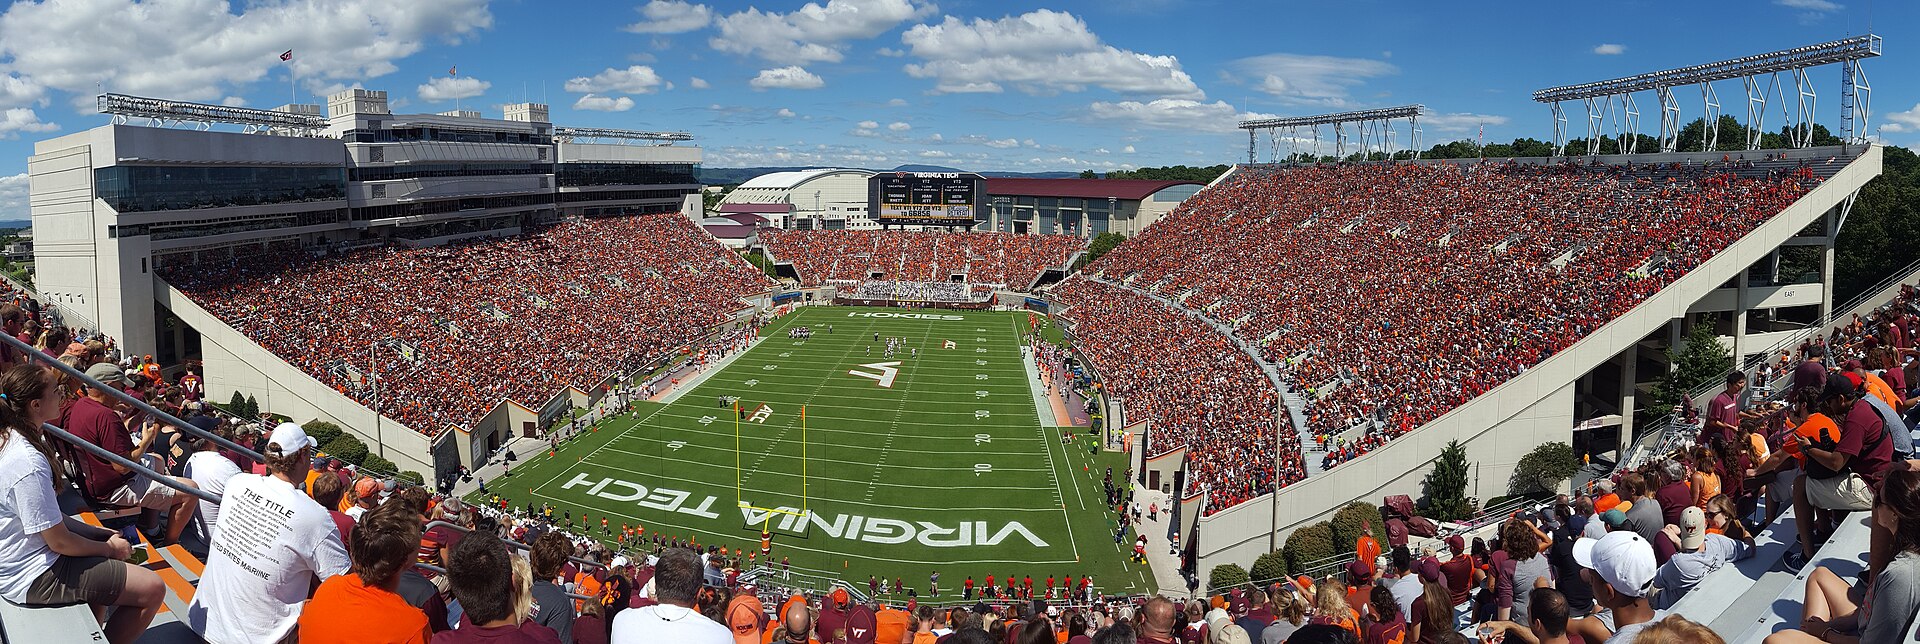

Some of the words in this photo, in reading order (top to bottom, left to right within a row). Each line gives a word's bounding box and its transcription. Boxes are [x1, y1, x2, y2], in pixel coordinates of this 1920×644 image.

[848, 312, 964, 320] HOKIES
[749, 404, 774, 424] ACC
[975, 434, 991, 443] 20
[974, 464, 992, 472] 10
[244, 488, 263, 503] THE
[266, 500, 294, 518] TITLE
[561, 472, 719, 519] TECH
[738, 501, 1050, 547] VIRGINIA
[223, 548, 240, 564] STATES
[241, 561, 270, 580] MARINE
[852, 627, 867, 638] VT
